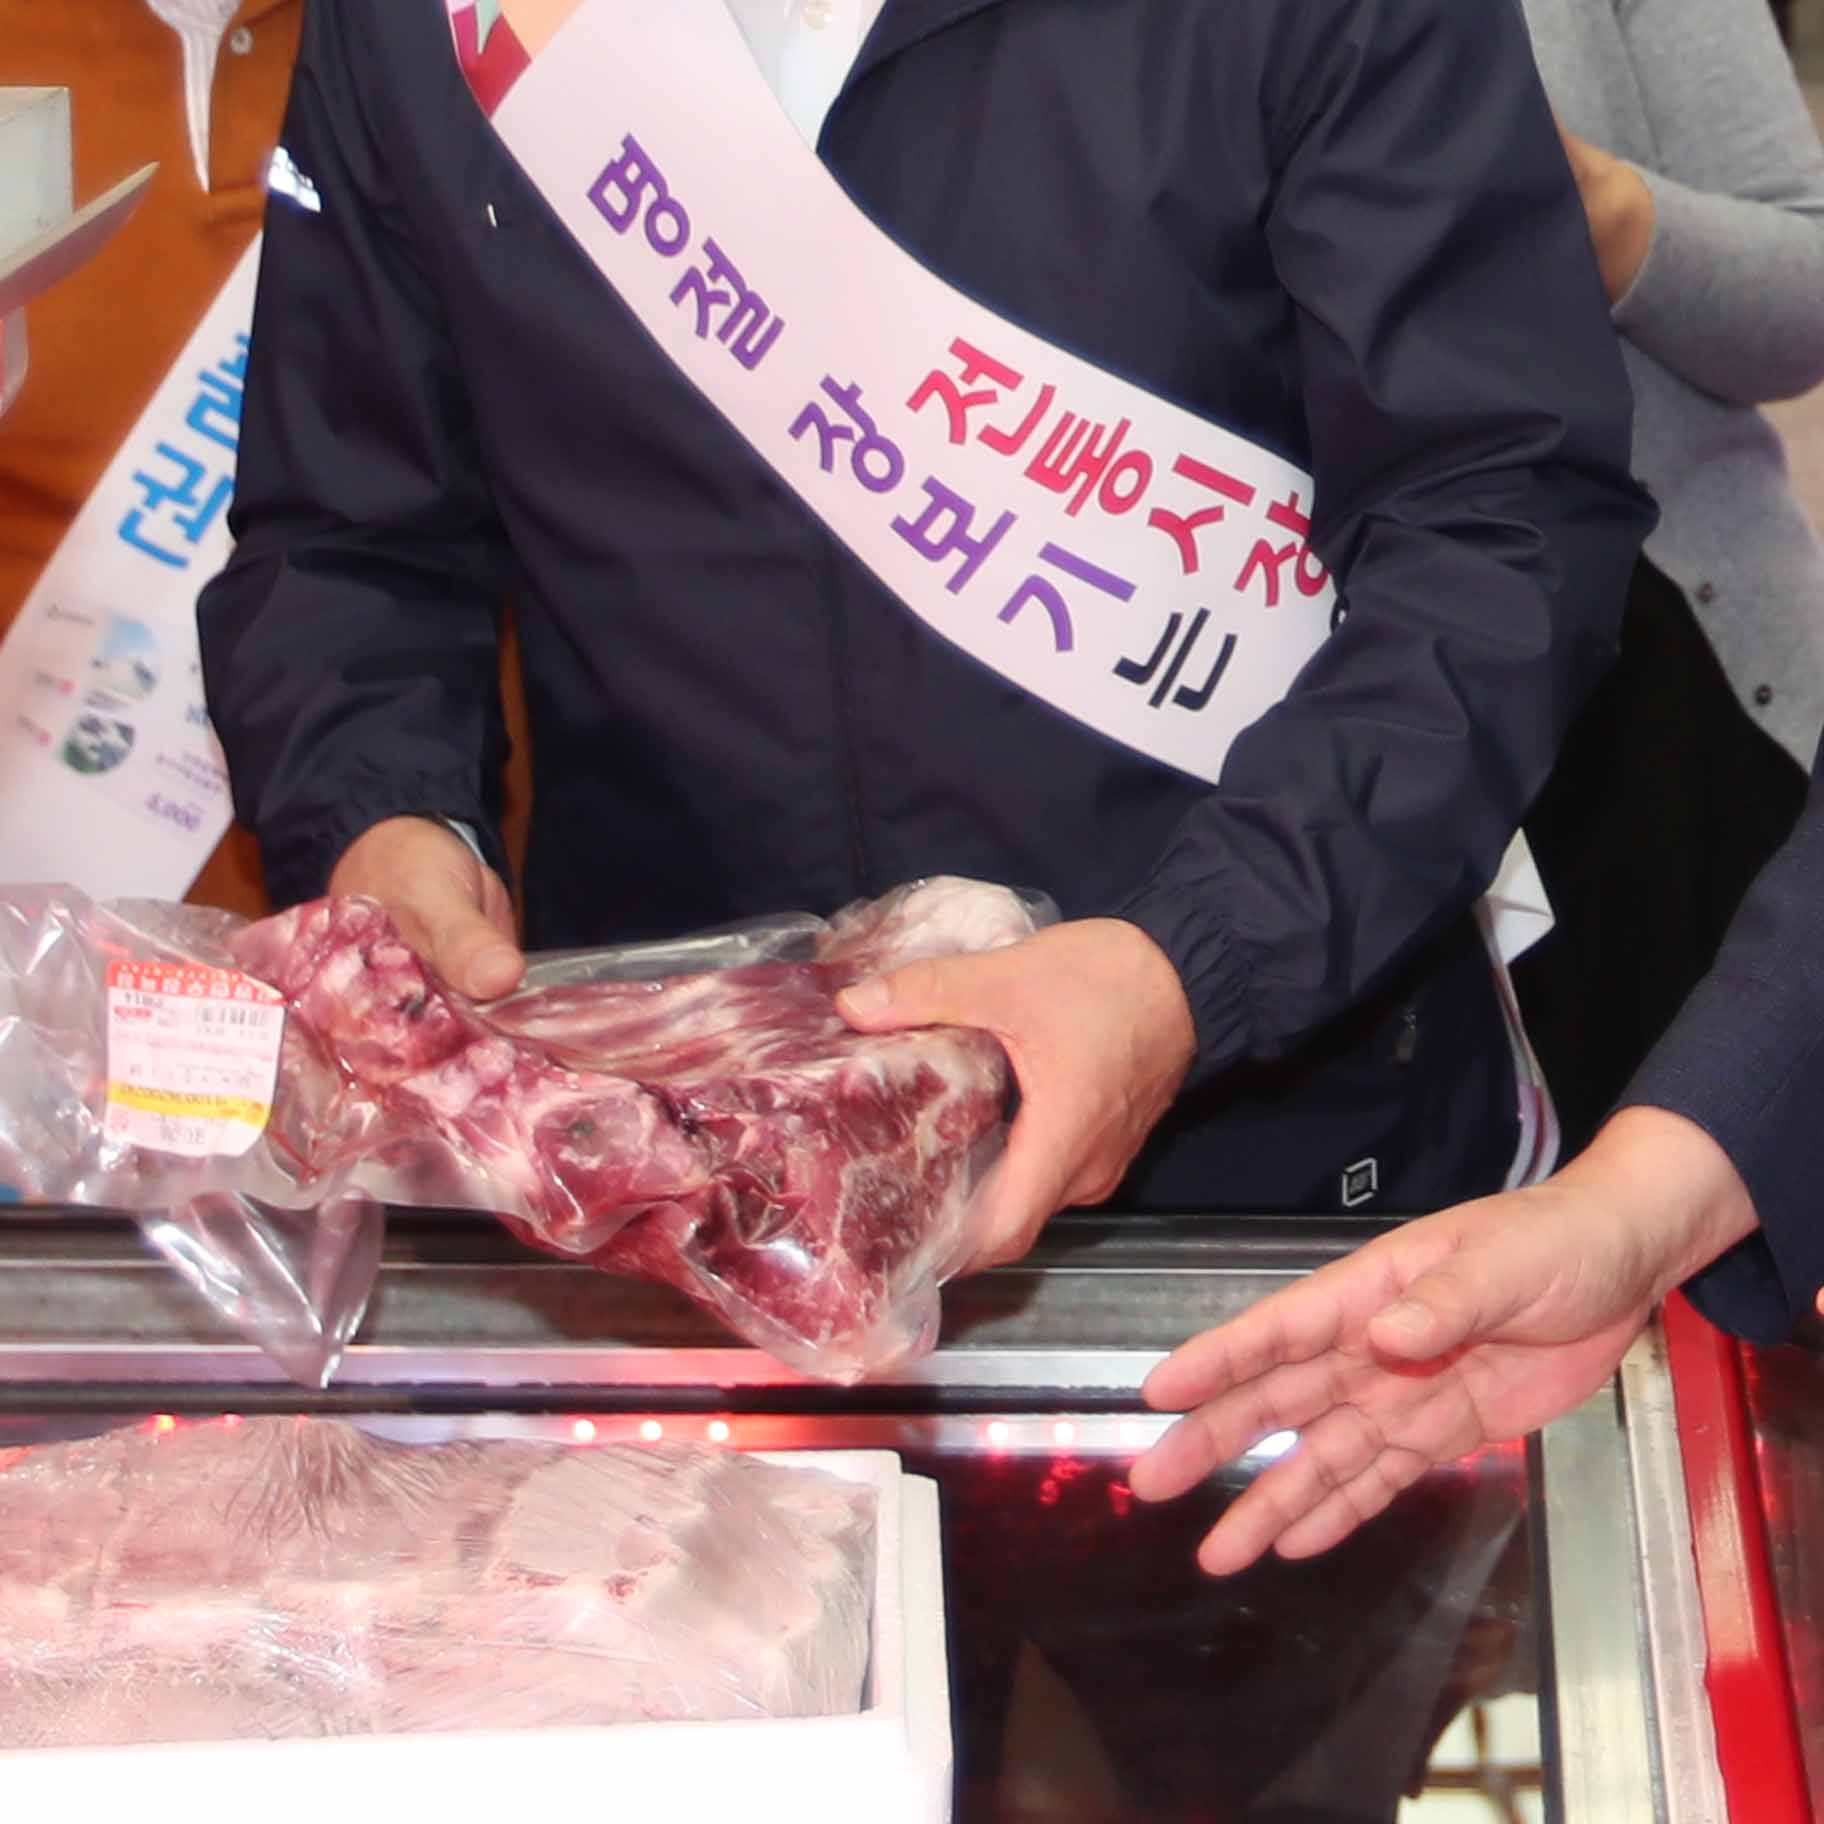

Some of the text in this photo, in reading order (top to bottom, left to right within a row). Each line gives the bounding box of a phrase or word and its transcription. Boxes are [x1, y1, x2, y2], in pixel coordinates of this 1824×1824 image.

[587, 134, 1237, 709] 명절 장보기는
[904, 338, 1331, 608] 전통시장
